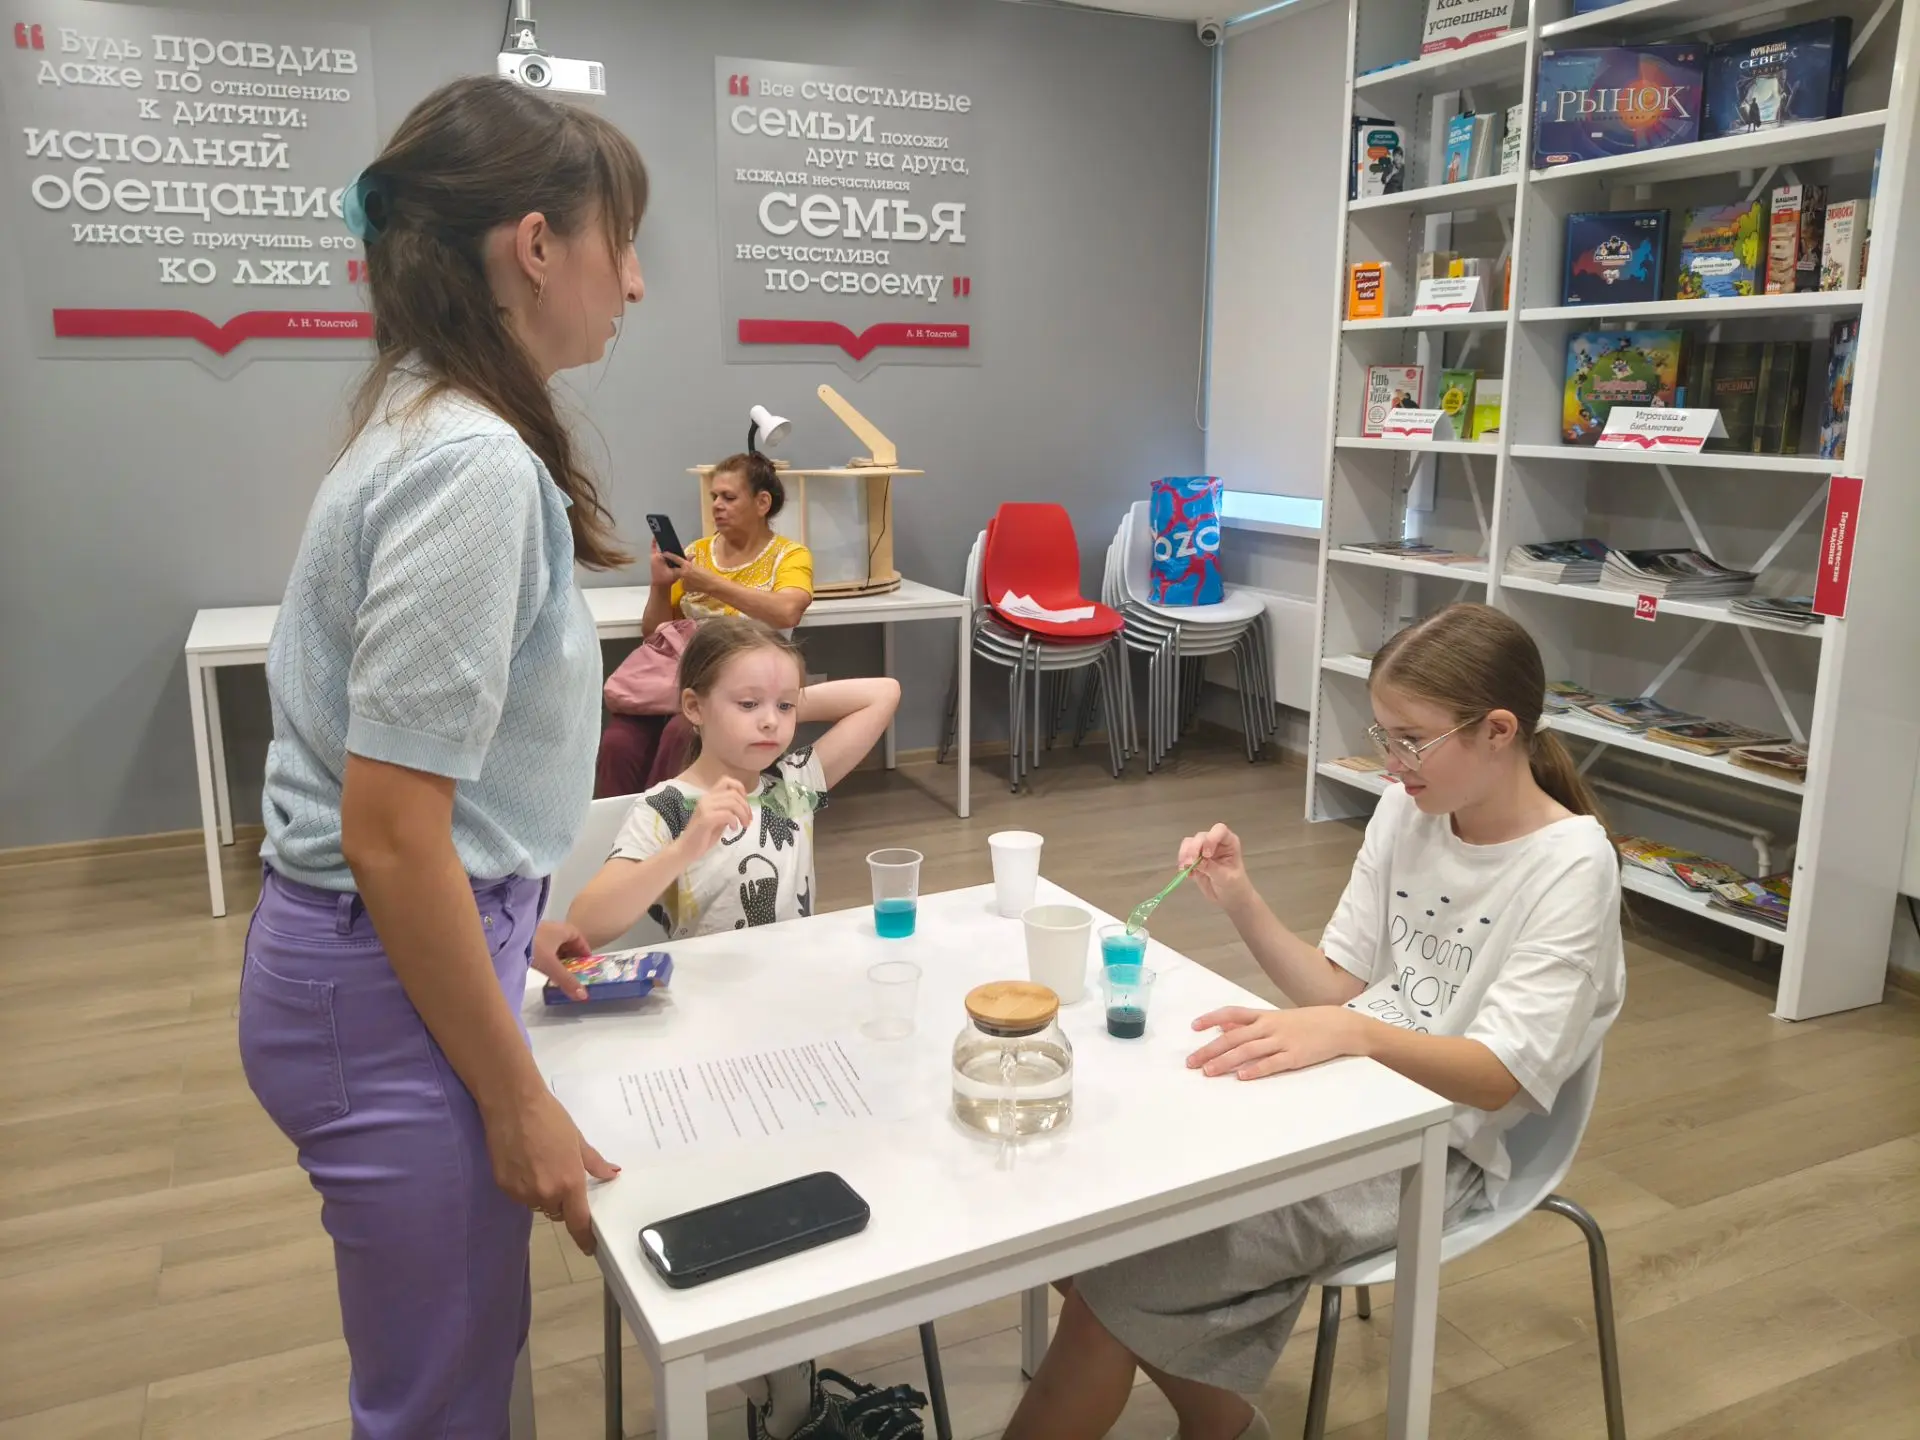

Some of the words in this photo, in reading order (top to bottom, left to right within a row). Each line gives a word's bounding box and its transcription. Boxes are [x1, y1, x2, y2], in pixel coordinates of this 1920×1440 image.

[1428, 5, 1508, 35] успешным
[58, 28, 142, 60] Будь
[152, 34, 358, 76] правдив
[37, 60, 143, 87] даже
[155, 68, 202, 93] по
[210, 79, 350, 102] отношению
[759, 79, 794, 97] Все
[801, 81, 972, 113] счастливые
[137, 98, 161, 120] к
[173, 101, 308, 128] дитяти:
[1554, 85, 1691, 122] РЫНОК
[731, 105, 875, 144] семьи
[880, 131, 949, 149] похожи
[23, 127, 290, 169] исполняй
[806, 147, 858, 168] друг
[865, 150, 895, 168] на
[901, 155, 969, 176] друга,
[735, 168, 808, 186] каждая
[812, 175, 911, 191] несчастливая
[758, 191, 967, 244] семья
[72, 223, 185, 245] иначе
[192, 230, 313, 250] приучишь
[319, 236, 357, 250] его
[735, 243, 890, 265] несчастлива
[158, 257, 217, 285] ко
[233, 260, 331, 286] лжи
[765, 268, 944, 303] по-своему
[301, 318, 312, 328] Н.
[314, 318, 358, 329] Толстой
[925, 329, 958, 339] Толстой
[1629, 421, 1683, 432] библиотеке
[1635, 410, 1678, 422] Игротека
[1827, 527, 1838, 565] издания
[1832, 511, 1848, 583] Периодические
[1638, 600, 1655, 613] 12+
[1391, 915, 1473, 973] Droom
